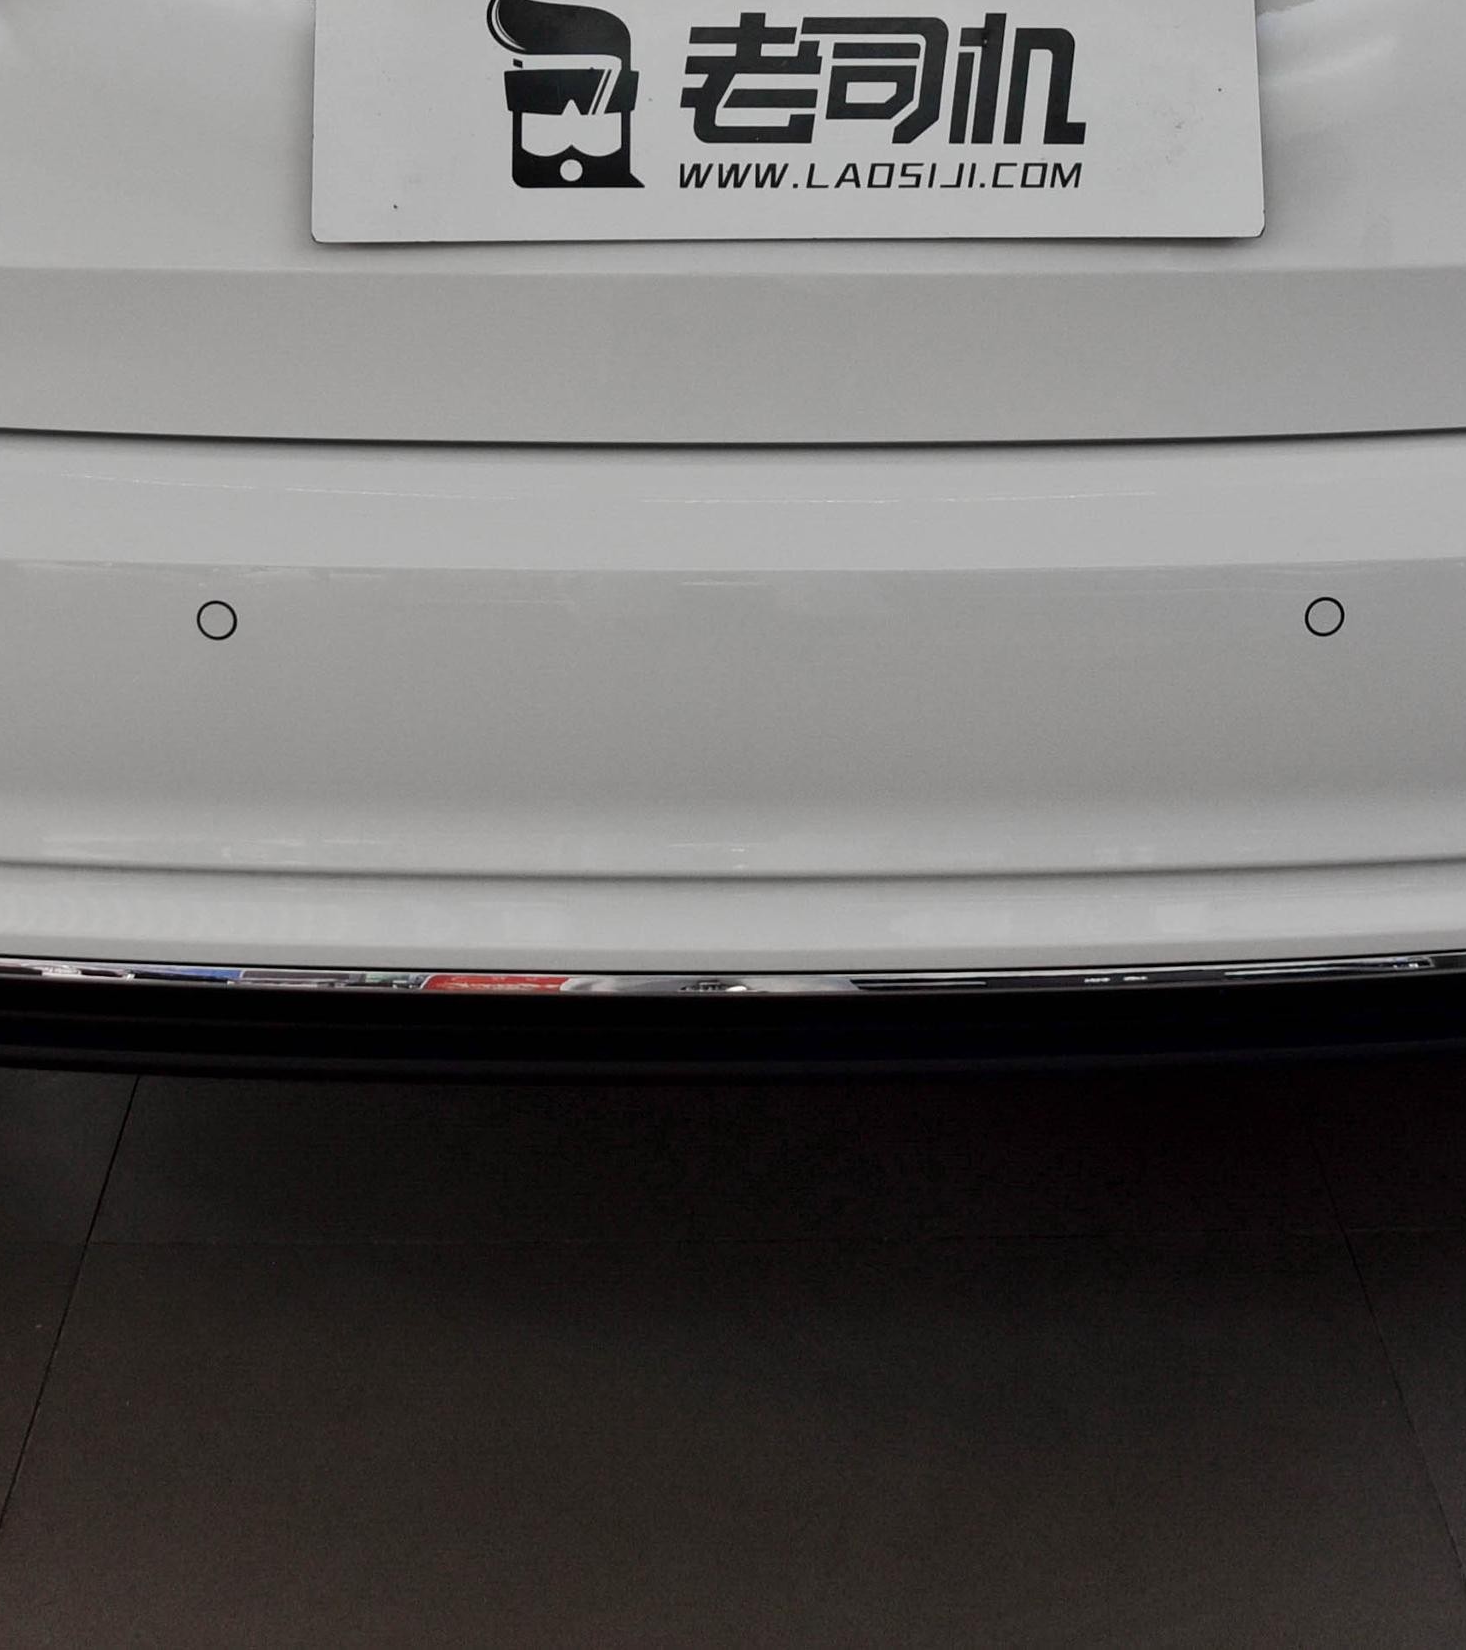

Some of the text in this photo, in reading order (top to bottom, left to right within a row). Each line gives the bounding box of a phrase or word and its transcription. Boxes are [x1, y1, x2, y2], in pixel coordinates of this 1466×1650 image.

[679, 11, 1087, 146] 老司机
[678, 161, 1084, 191] WWW.LAOSIJI.COM
